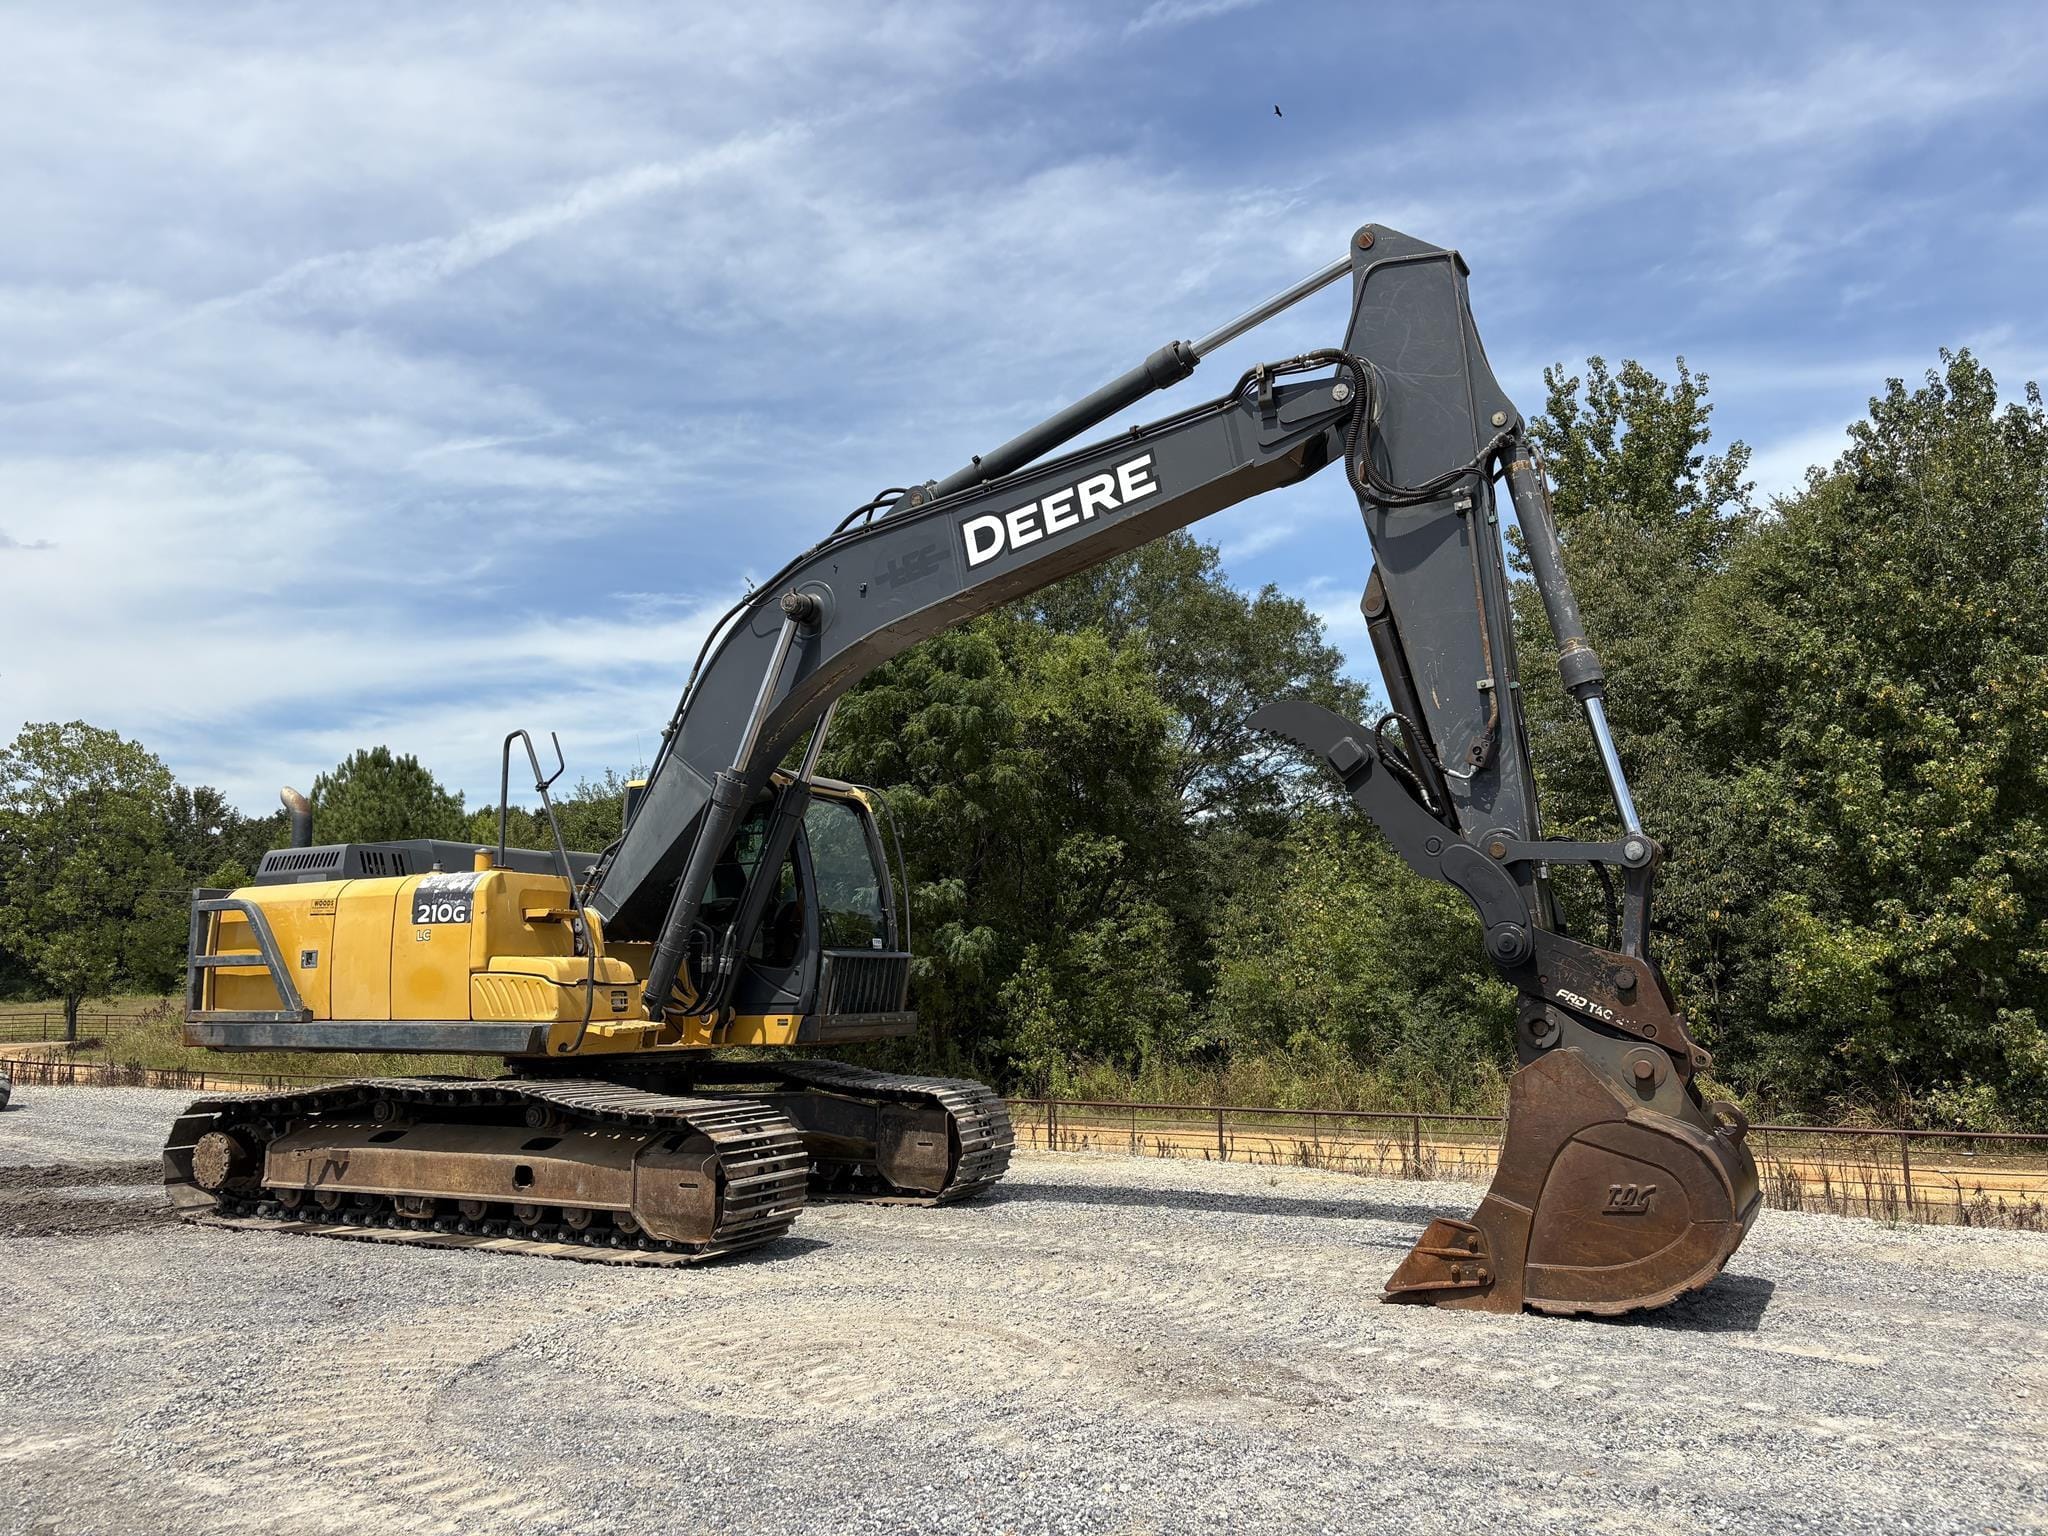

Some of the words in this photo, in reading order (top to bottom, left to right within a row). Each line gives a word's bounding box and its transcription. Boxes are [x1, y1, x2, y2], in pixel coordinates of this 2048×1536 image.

[962, 454, 1158, 567] DEERE
[417, 904, 466, 923] 210G
[416, 929, 432, 941] LC
